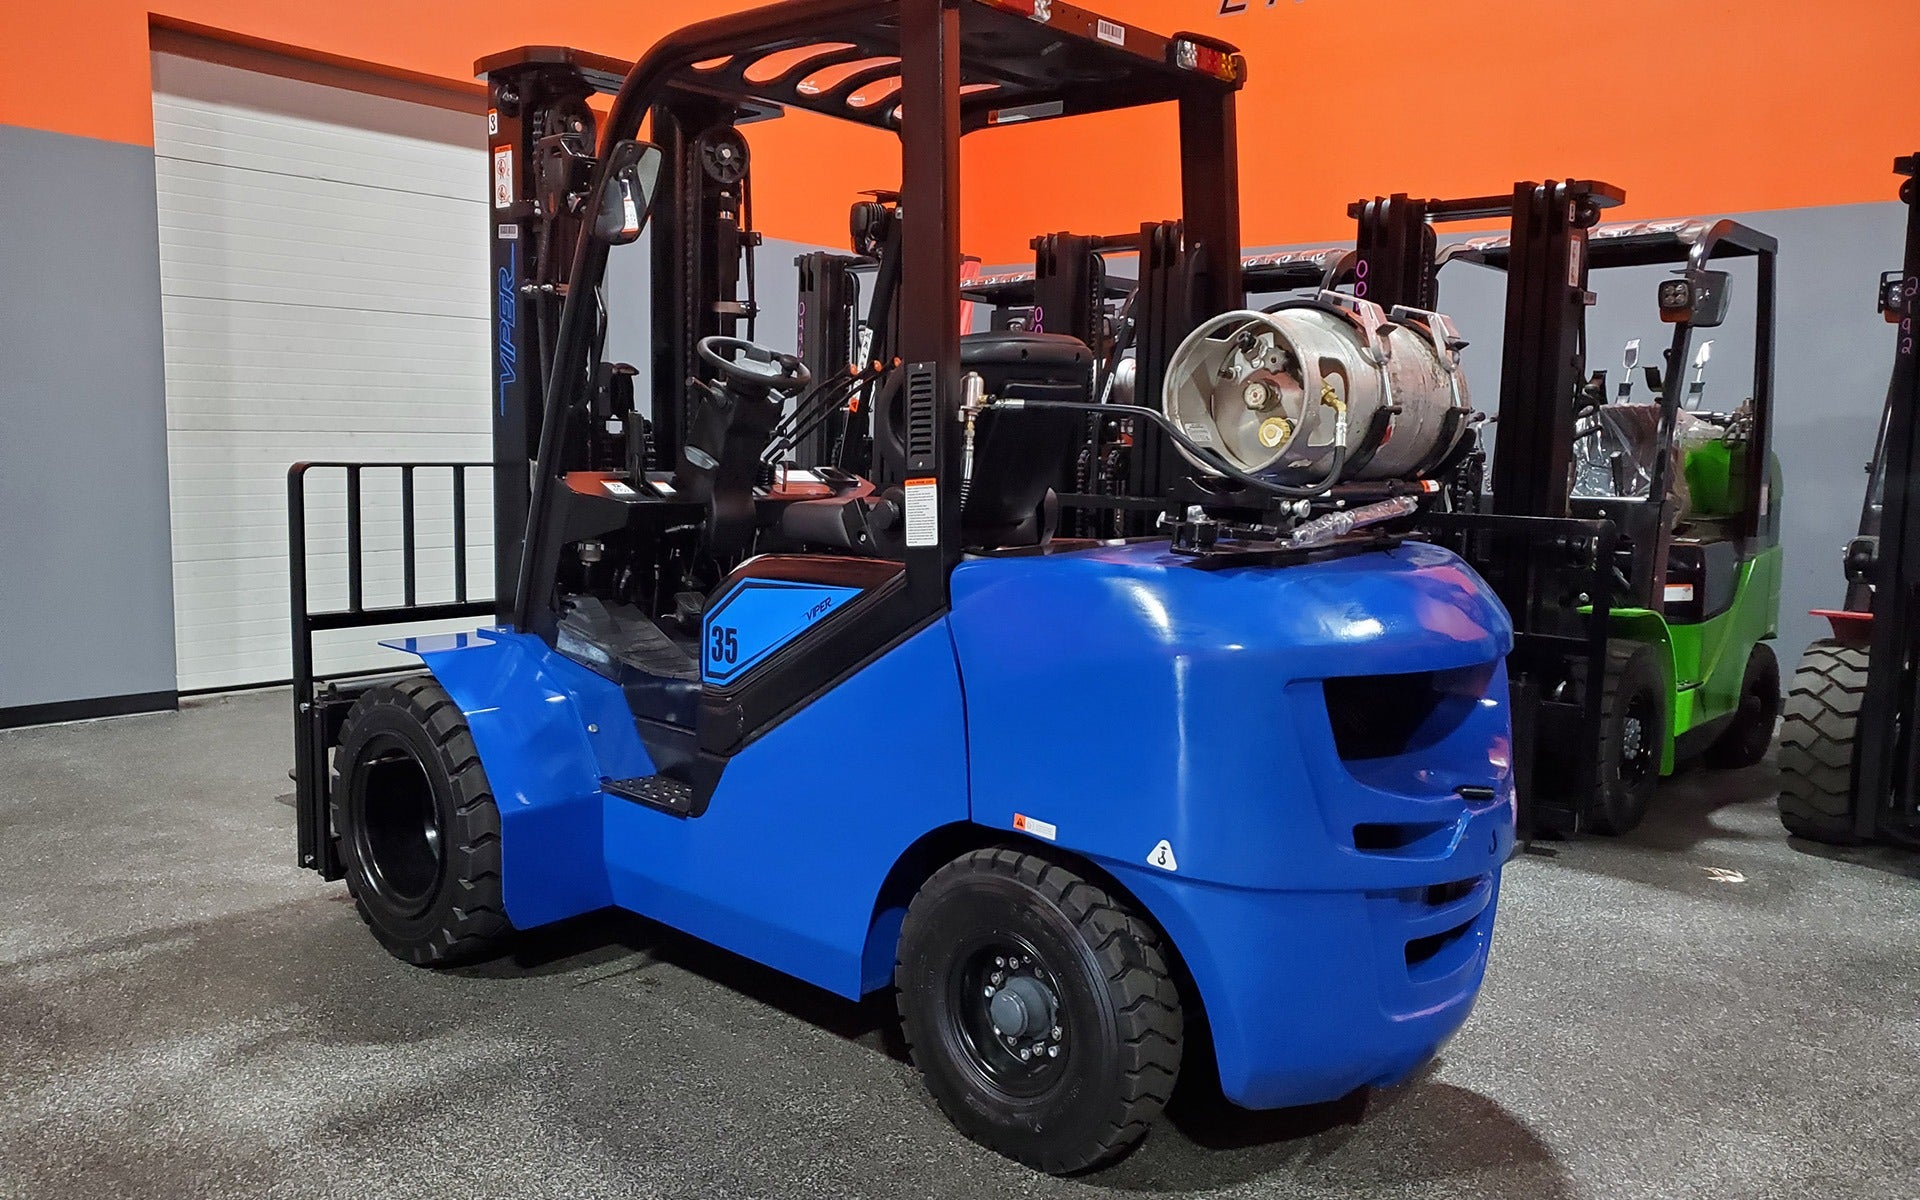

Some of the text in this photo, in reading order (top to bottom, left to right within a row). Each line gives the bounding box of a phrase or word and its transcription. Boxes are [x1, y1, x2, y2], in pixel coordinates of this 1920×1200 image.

[498, 243, 516, 416] VIPER
[1901, 276, 1918, 354] 2192
[801, 597, 836, 621] VIPER
[711, 626, 738, 664] 35
